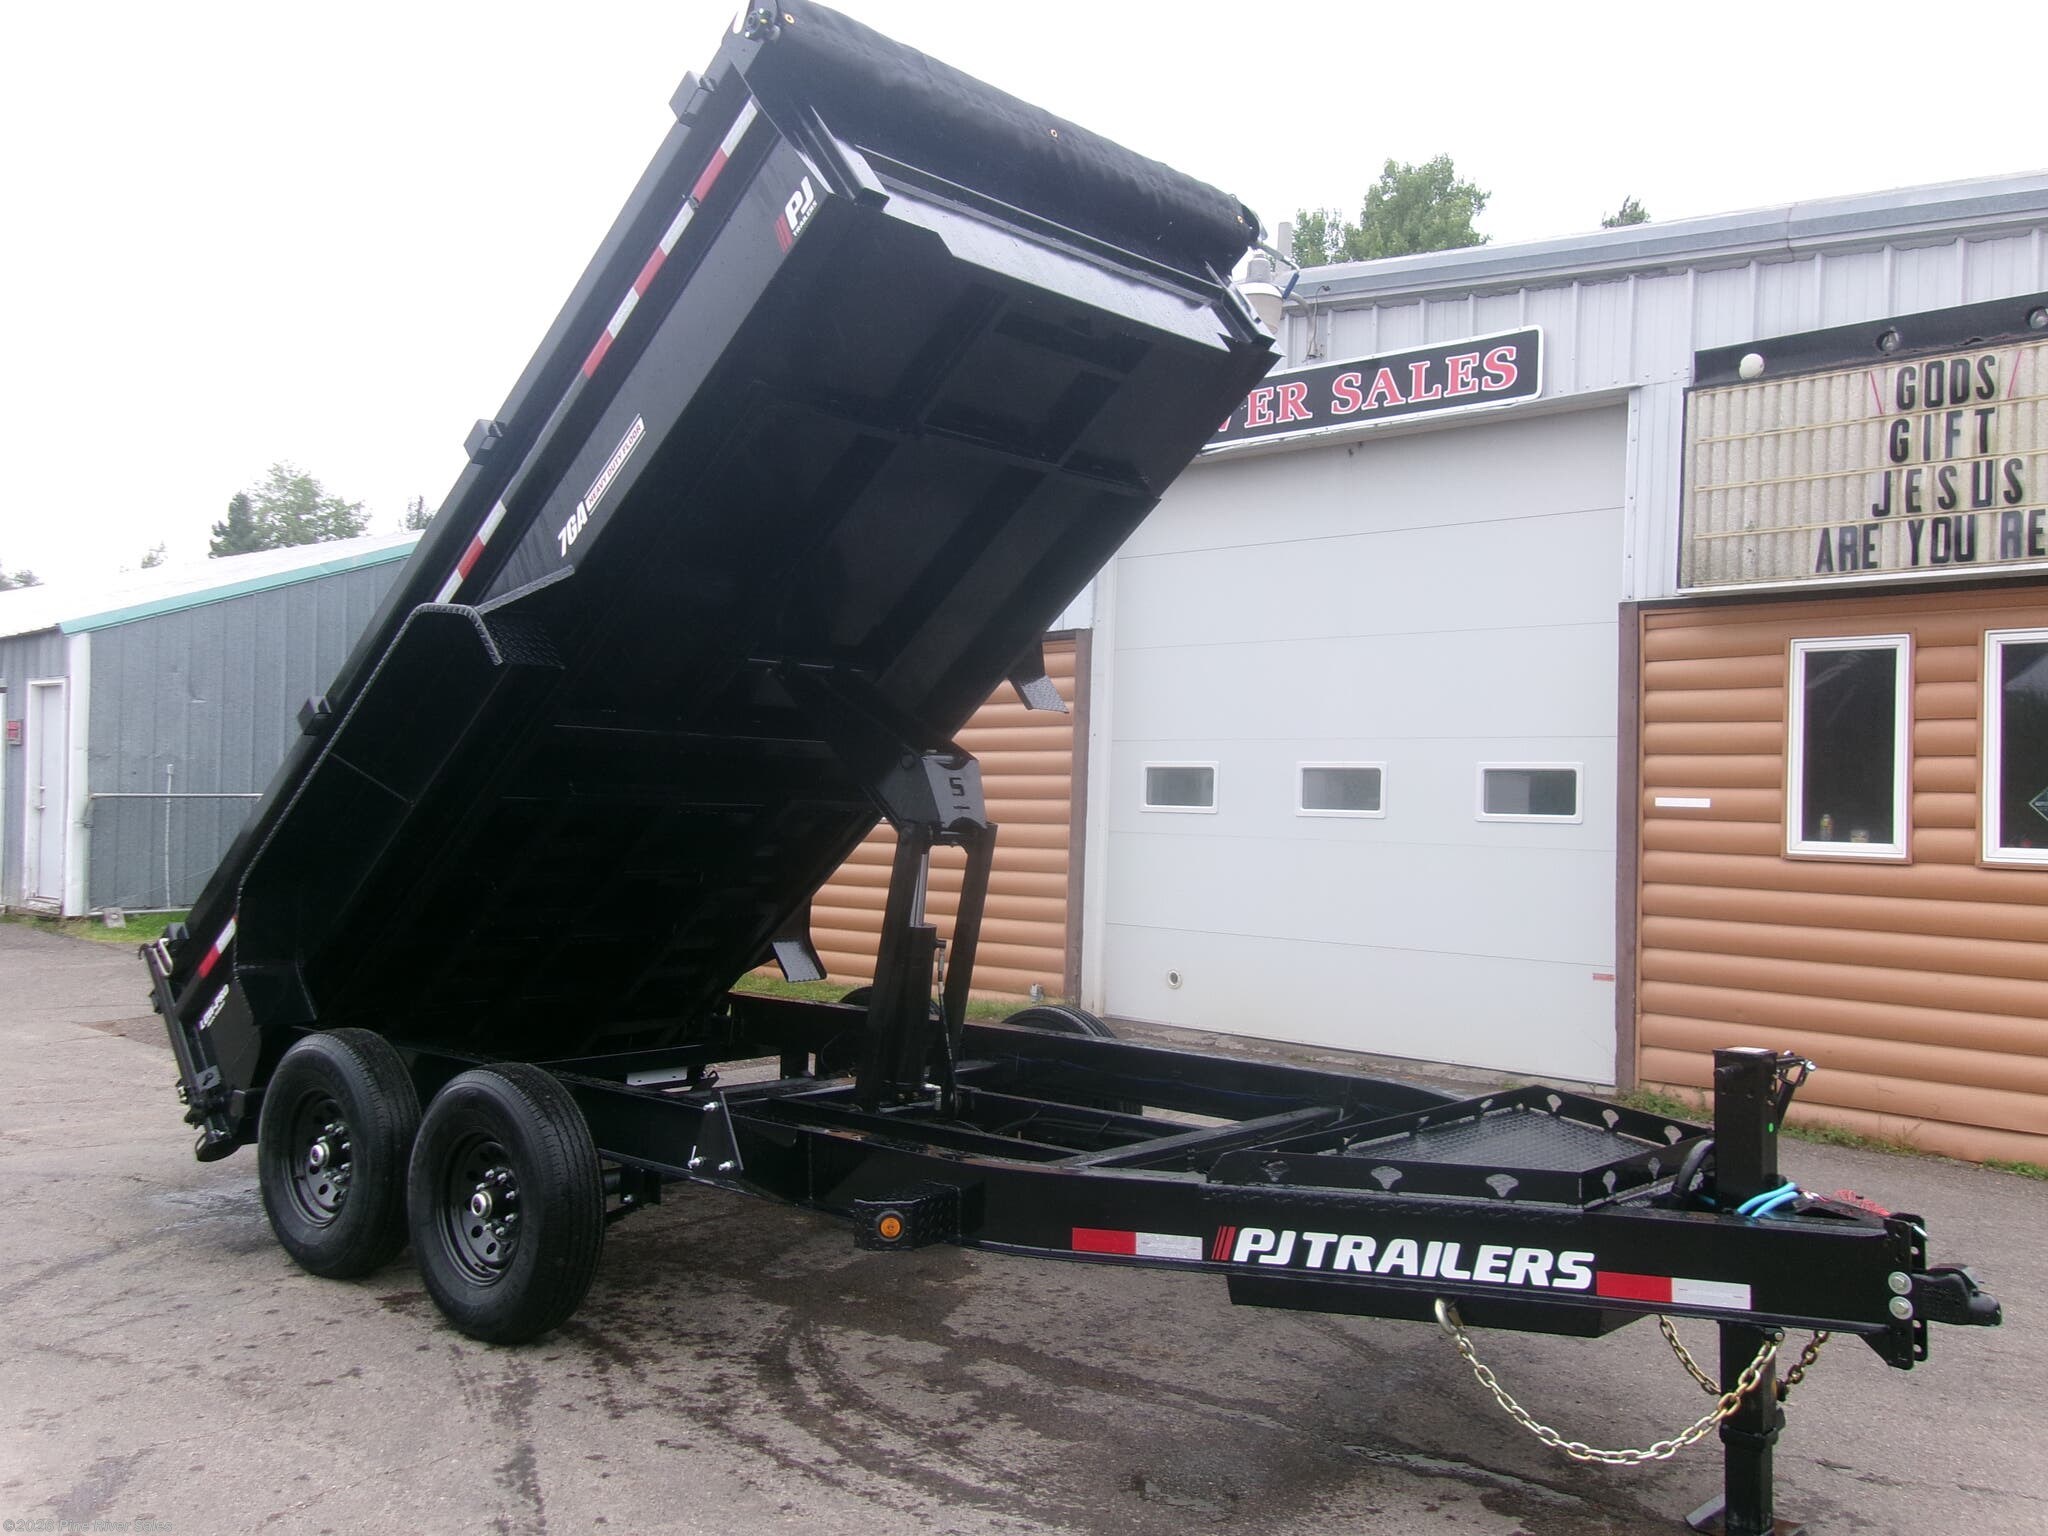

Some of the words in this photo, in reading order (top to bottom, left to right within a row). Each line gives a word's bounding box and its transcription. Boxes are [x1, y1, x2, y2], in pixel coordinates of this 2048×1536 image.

[785, 176, 814, 230] PJ
[792, 200, 817, 236] TRAILERS
[1331, 346, 1518, 415] SALES
[1896, 354, 1996, 411] GODS
[1889, 407, 1996, 463] GIFT
[557, 501, 588, 557] 7GA
[588, 477, 607, 505] HEAVY
[606, 453, 623, 477] DUTY
[621, 423, 642, 453] FLOOR
[1872, 458, 2024, 517] JESUS
[1815, 523, 1880, 574] ARE
[1908, 513, 1976, 566] YOU
[1233, 1227, 1297, 1265] PJ
[1302, 1231, 1595, 1289] TRAILERS
